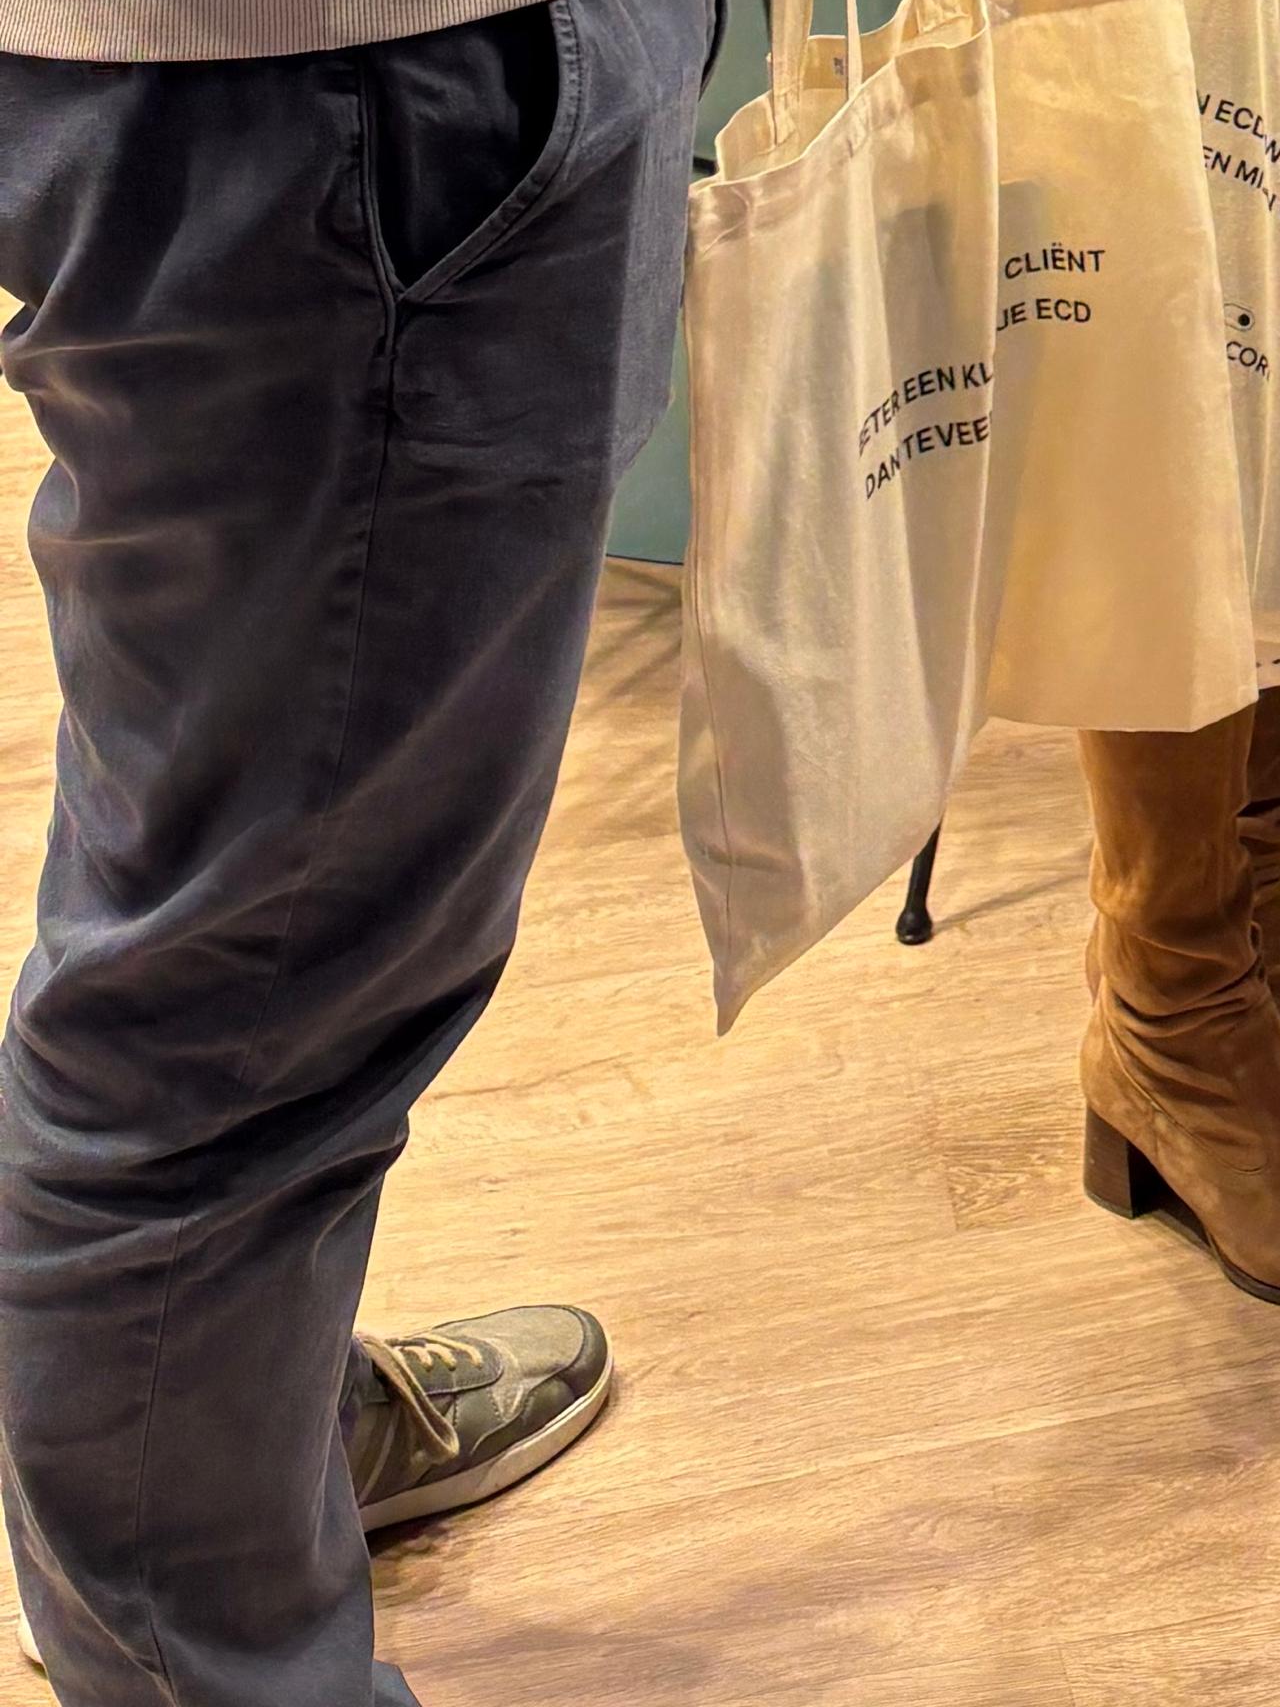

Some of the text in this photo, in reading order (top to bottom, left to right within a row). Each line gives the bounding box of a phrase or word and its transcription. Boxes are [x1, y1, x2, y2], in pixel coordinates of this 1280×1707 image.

[1004, 241, 1106, 279] CLIËNT
[996, 298, 1092, 332] JE ECD
[903, 365, 956, 405] EEN
[865, 410, 993, 500] DAN TEVEE
